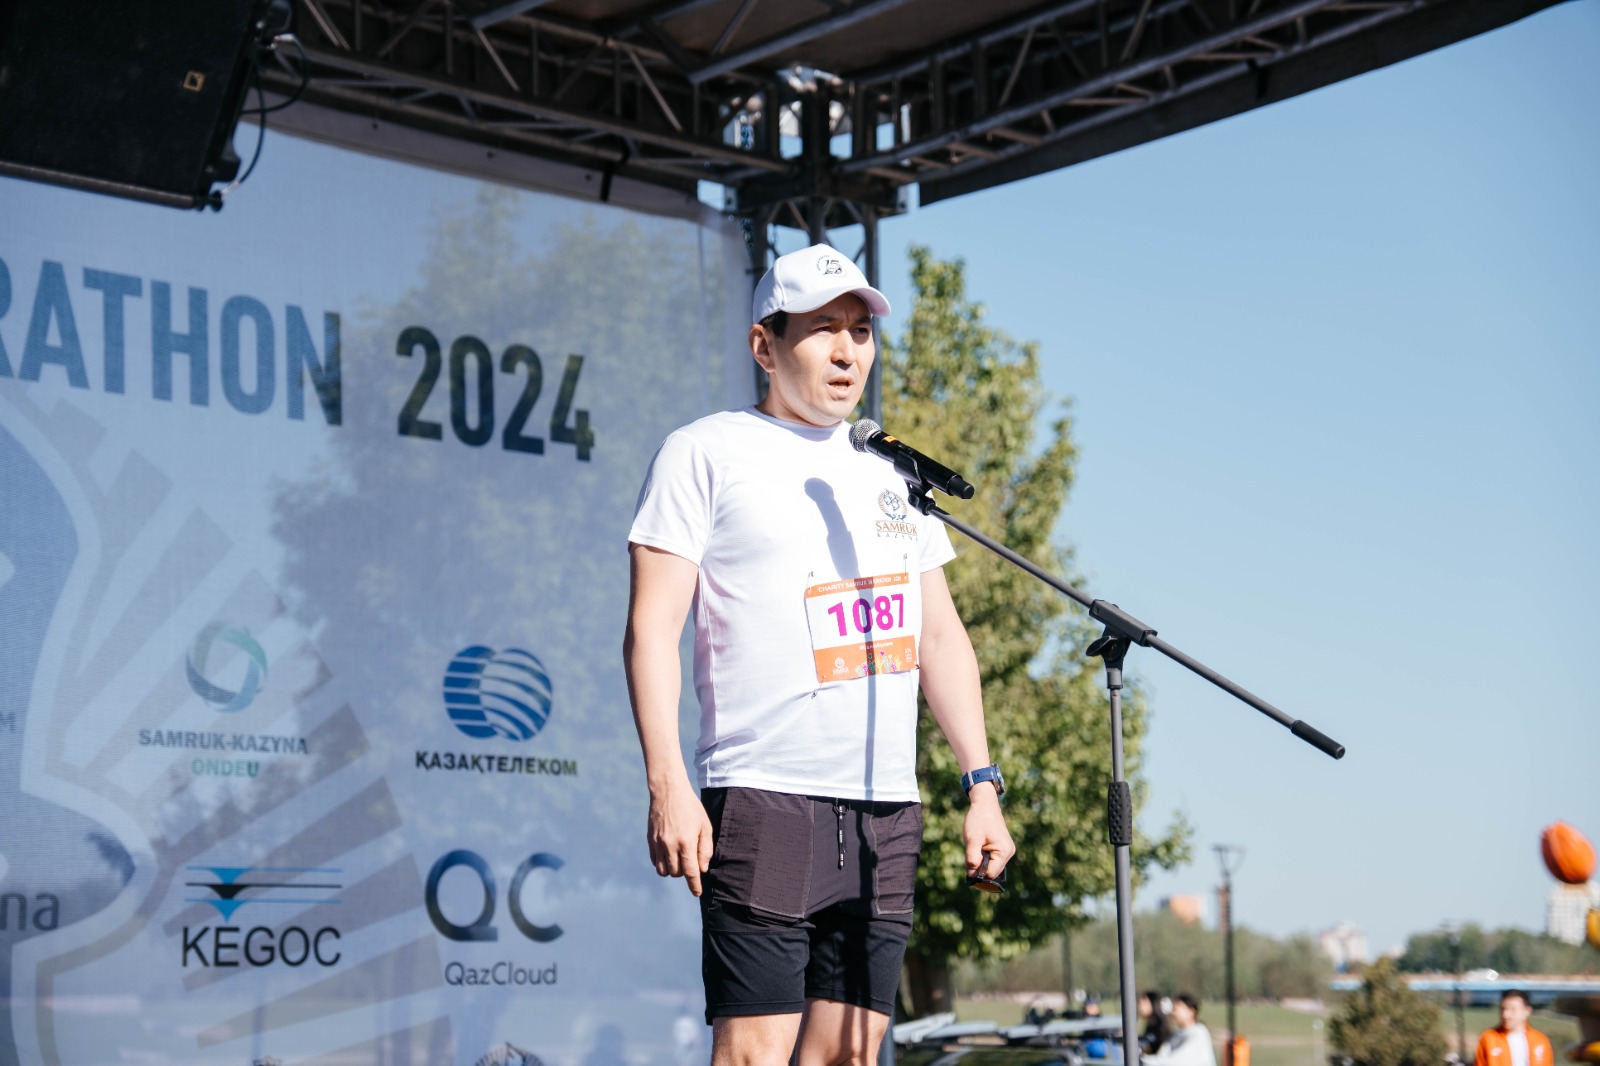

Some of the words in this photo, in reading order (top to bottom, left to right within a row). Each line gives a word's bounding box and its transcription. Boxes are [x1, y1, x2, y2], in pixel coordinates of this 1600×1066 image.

[0, 255, 343, 427] ATHON
[396, 325, 596, 462] 2024
[875, 521, 918, 536] SAMRUK
[818, 582, 844, 593] CHARITY
[828, 593, 904, 637] 1087
[139, 728, 308, 755] SAMRUK-KAZYNA
[191, 757, 260, 778] ONDEU
[415, 751, 578, 777] ҚАЗАҚТЕЛЕКОМ
[424, 848, 565, 944] QC
[181, 926, 342, 968] KEGOC
[444, 960, 558, 987] QazCloud
